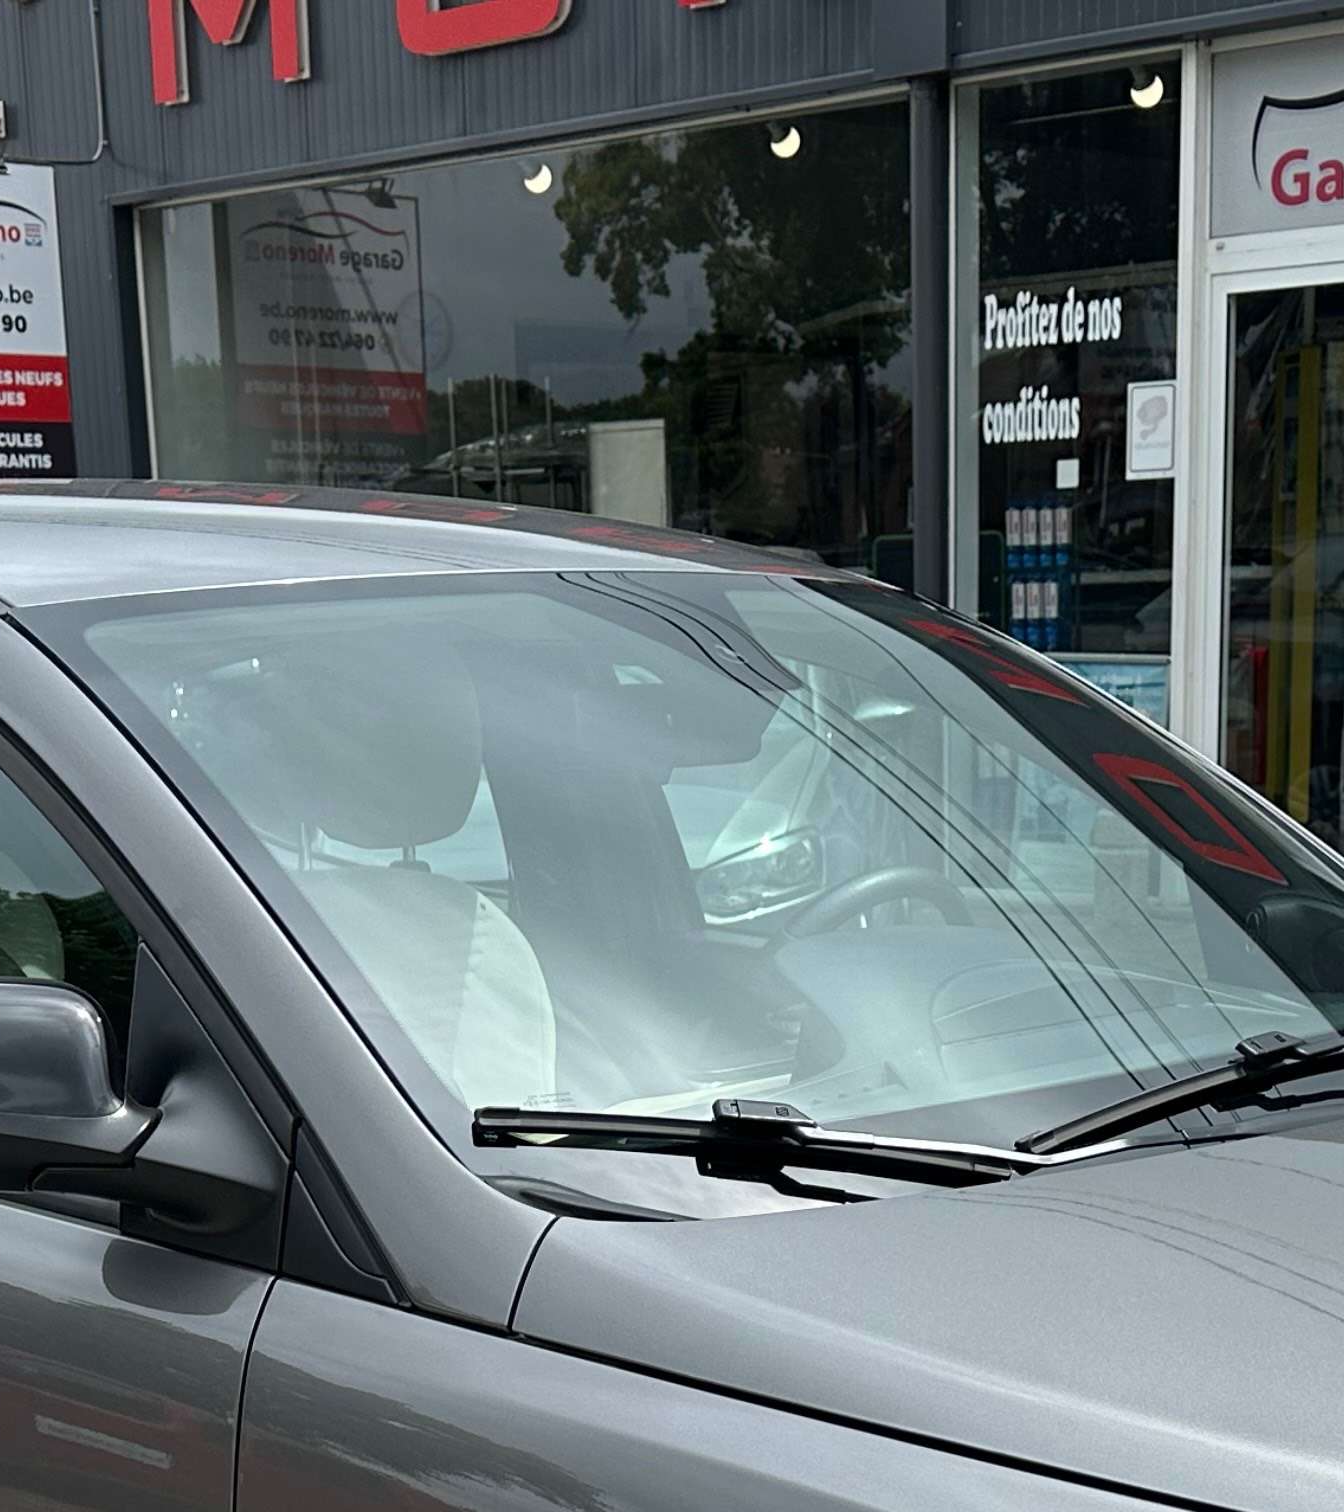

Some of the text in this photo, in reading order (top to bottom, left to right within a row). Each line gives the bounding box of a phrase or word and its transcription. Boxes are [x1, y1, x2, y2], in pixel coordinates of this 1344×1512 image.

[2, 313, 27, 333] 90
[984, 287, 1122, 350] Profitez de nos
[15, 371, 63, 387] NEUFS
[983, 386, 1081, 444] conditions
